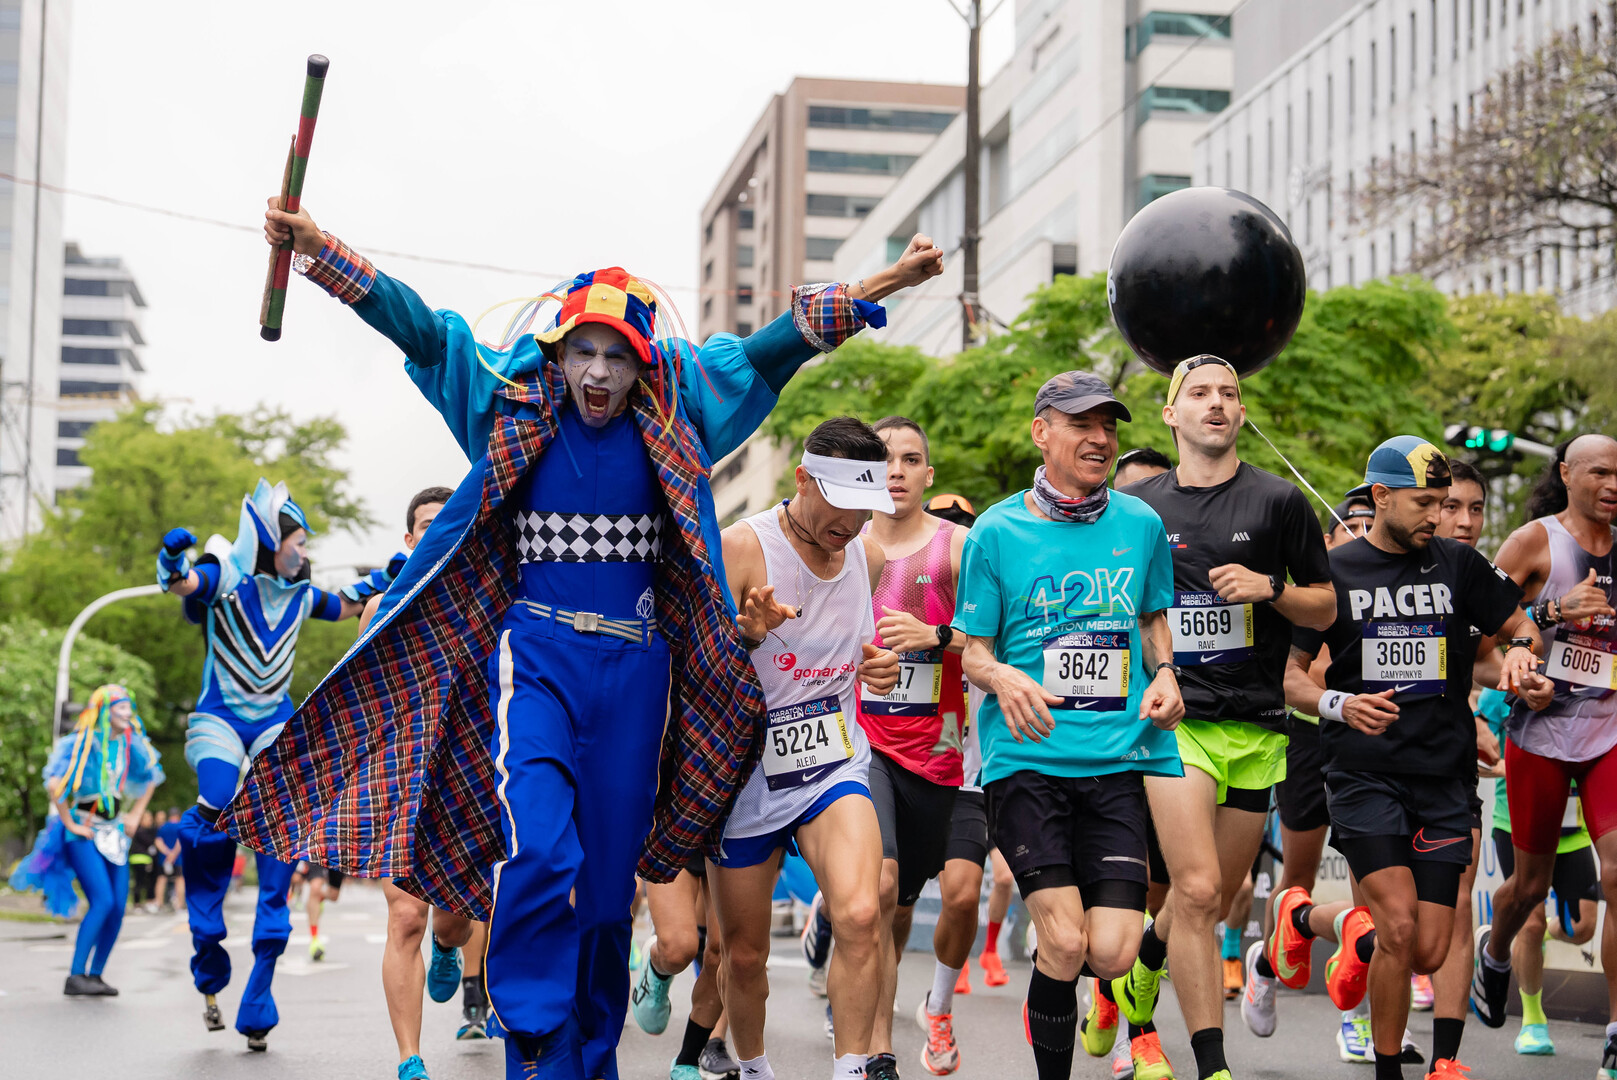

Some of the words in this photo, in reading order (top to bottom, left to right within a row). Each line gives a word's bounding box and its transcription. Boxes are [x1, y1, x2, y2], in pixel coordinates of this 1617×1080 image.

[1025, 567, 1136, 623] 42K
[1348, 583, 1454, 620] PACER
[1086, 617, 1135, 631] MEDELLÍN
[1180, 609, 1231, 636] 5669
[1410, 624, 1434, 636] 42K
[1093, 635, 1118, 647] 42K
[1198, 640, 1216, 650] RAVE
[1376, 641, 1426, 666] 3606
[1561, 647, 1601, 674] 6005
[1059, 652, 1109, 680] 3642
[1380, 670, 1422, 679] CAMYPINKYB
[883, 693, 901, 701] SANTI
[1072, 685, 1094, 695] GUILLE
[805, 700, 829, 715] 42K
[772, 720, 829, 757] 5224
[841, 723, 852, 749] CORRAL
[796, 755, 817, 768] ALEJO
[1318, 856, 1348, 880] anco
